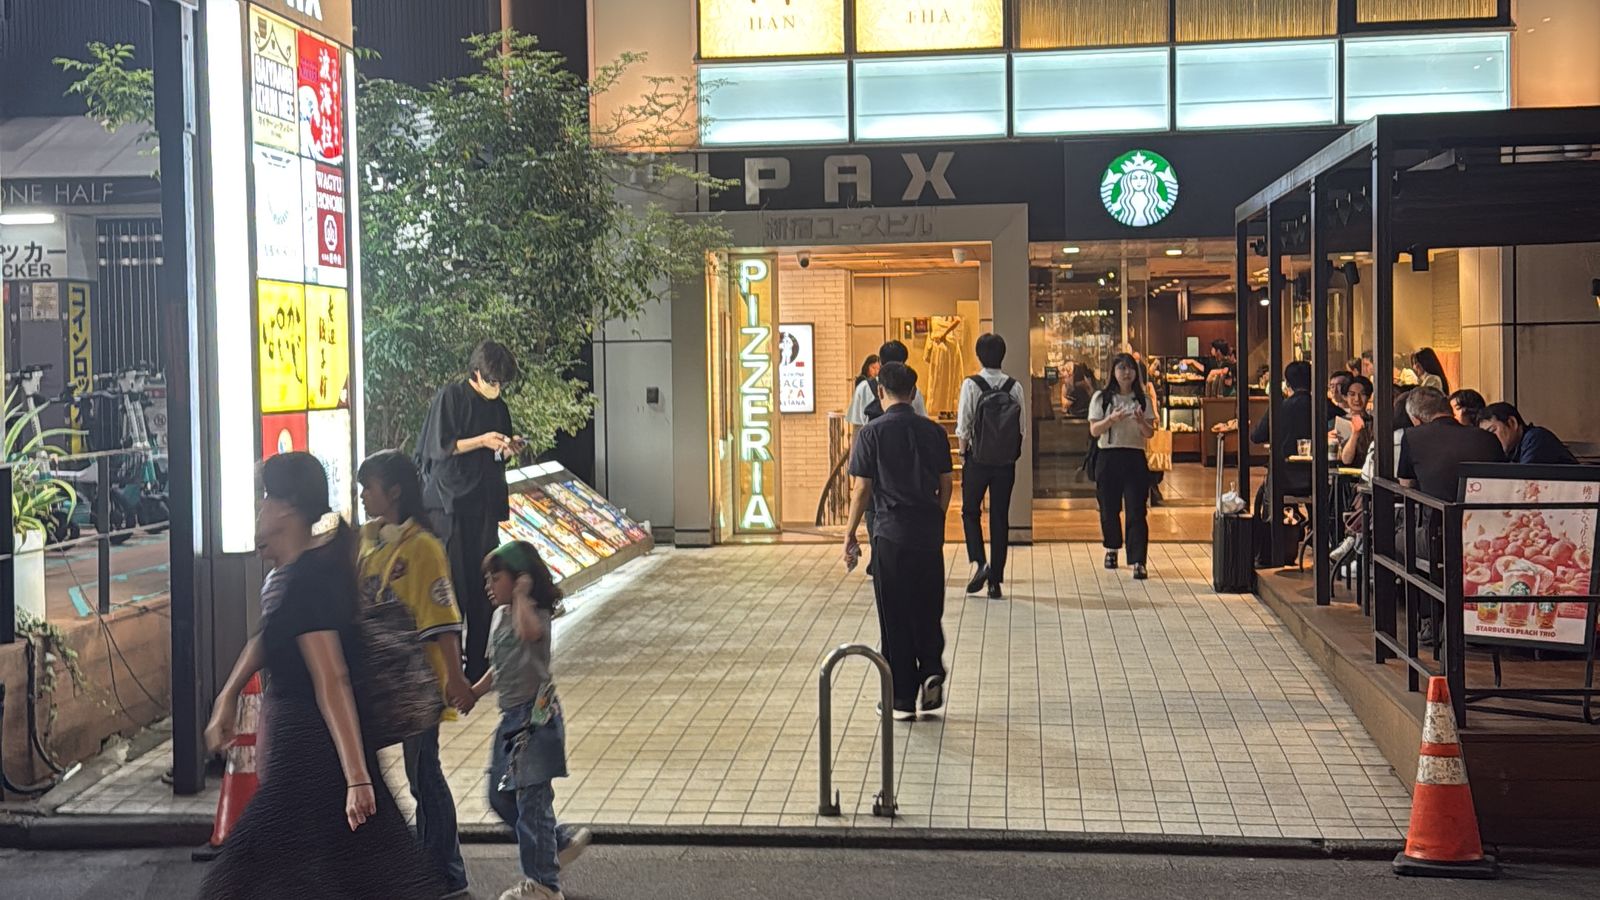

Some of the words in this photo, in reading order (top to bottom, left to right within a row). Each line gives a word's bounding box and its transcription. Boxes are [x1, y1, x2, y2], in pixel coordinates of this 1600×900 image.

[316, 170, 343, 194] WAGYU
[745, 151, 956, 205] PAX
[55, 183, 114, 203] HALF
[766, 214, 933, 241] 新宿ユースビル
[0, 241, 67, 264] ッカー
[738, 258, 776, 529] PIZZERIA
[1475, 625, 1515, 635] STARBUCKS
[1515, 628, 1539, 637] PEACH
[1539, 631, 1557, 639] TRIO
